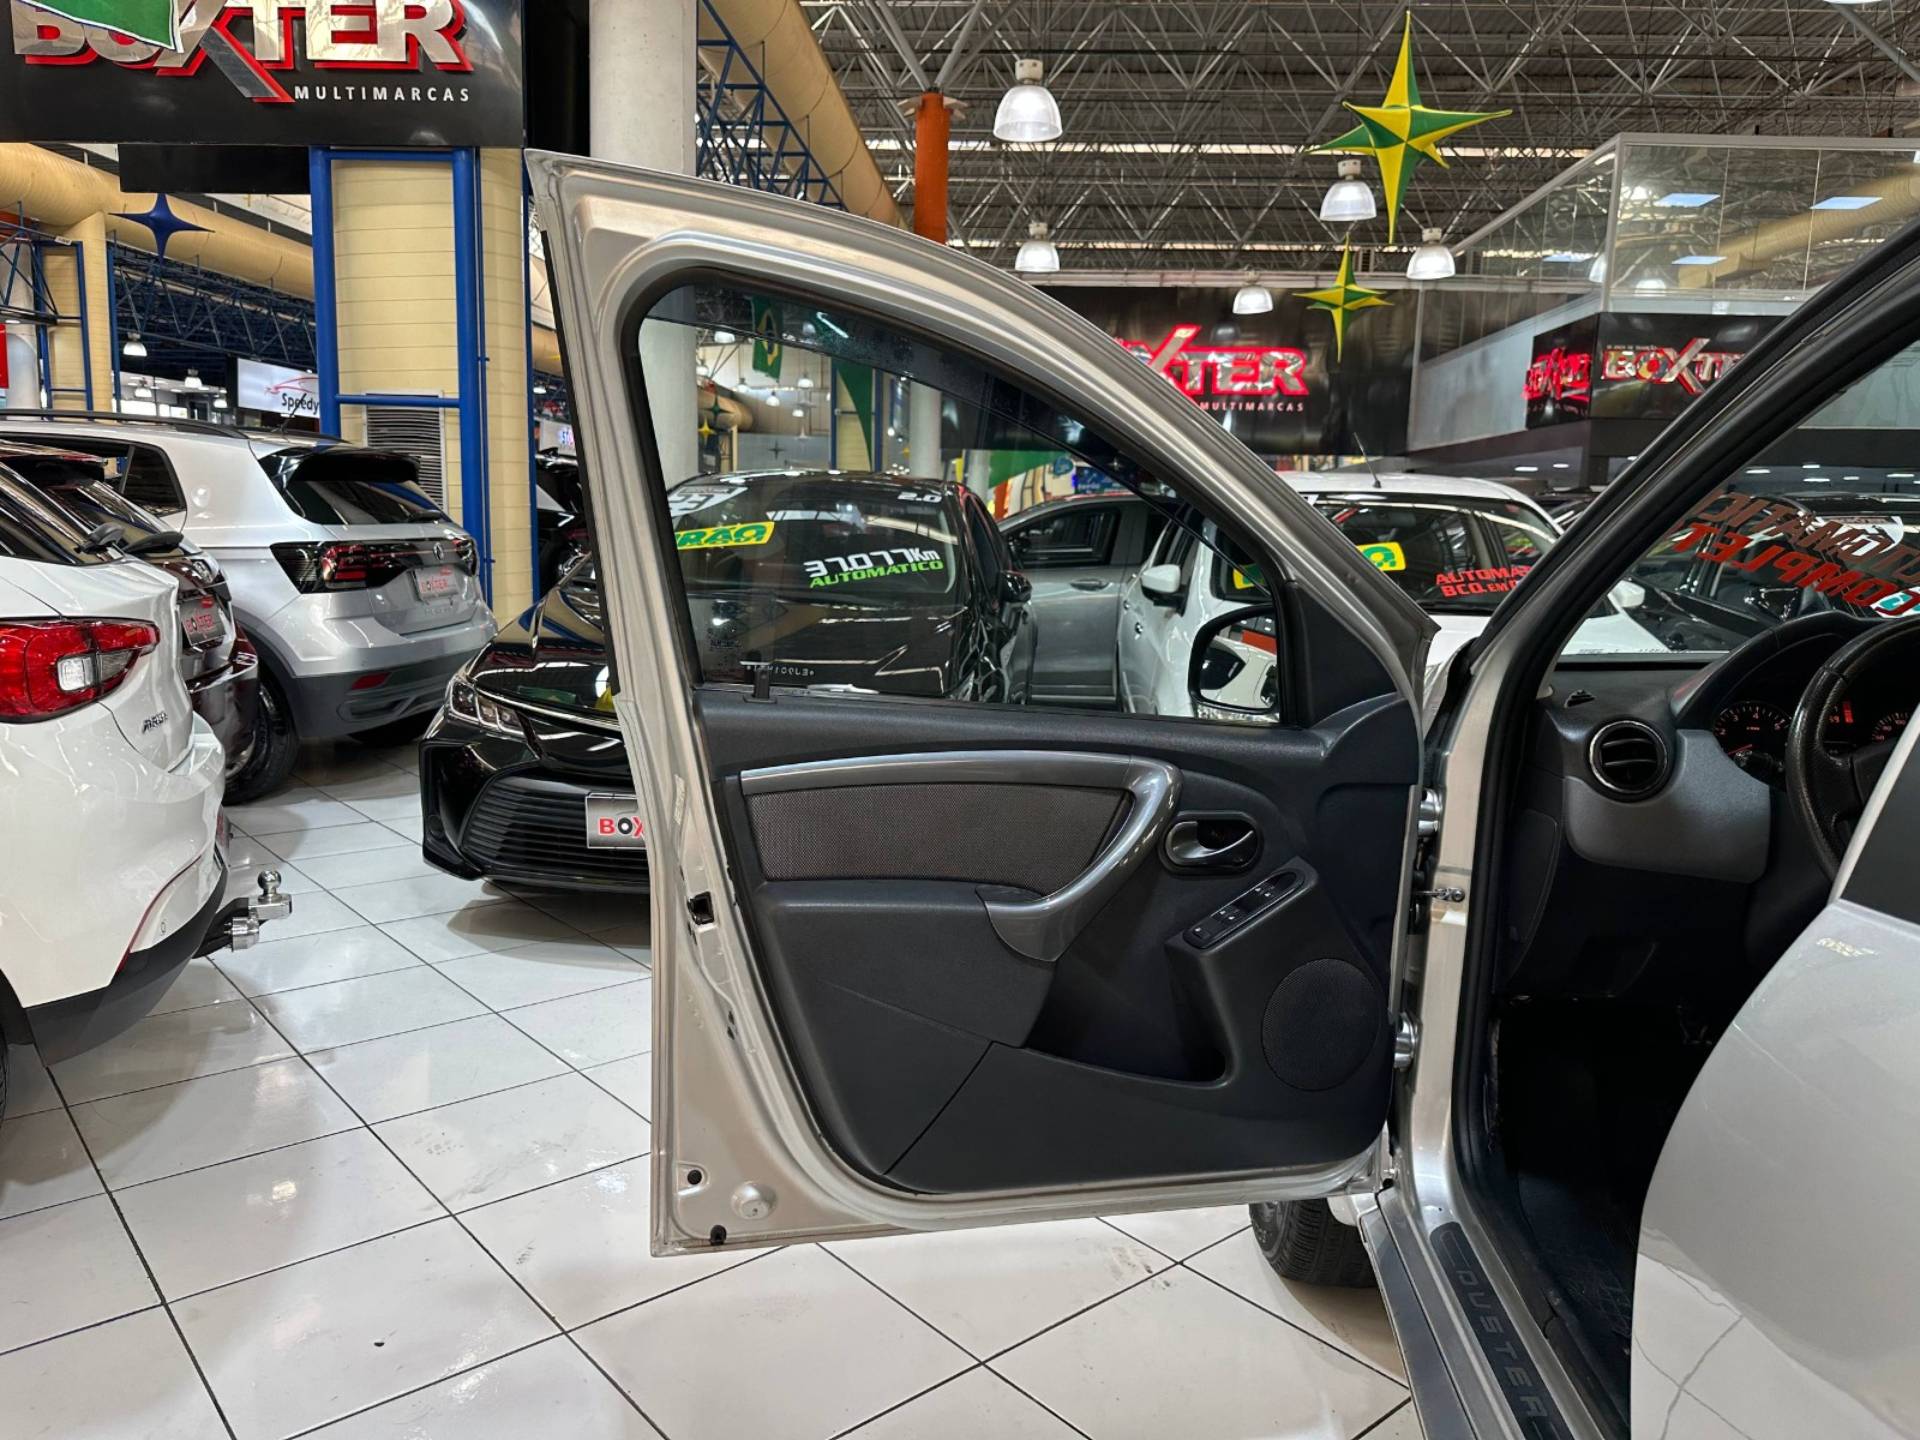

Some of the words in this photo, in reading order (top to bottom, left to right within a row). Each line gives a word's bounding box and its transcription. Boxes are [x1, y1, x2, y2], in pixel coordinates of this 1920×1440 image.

[294, 85, 470, 102] MULTIMARCAS
[1200, 402, 1304, 412] MULTIMARCAS
[1455, 1269, 1549, 1418] DUSTER
